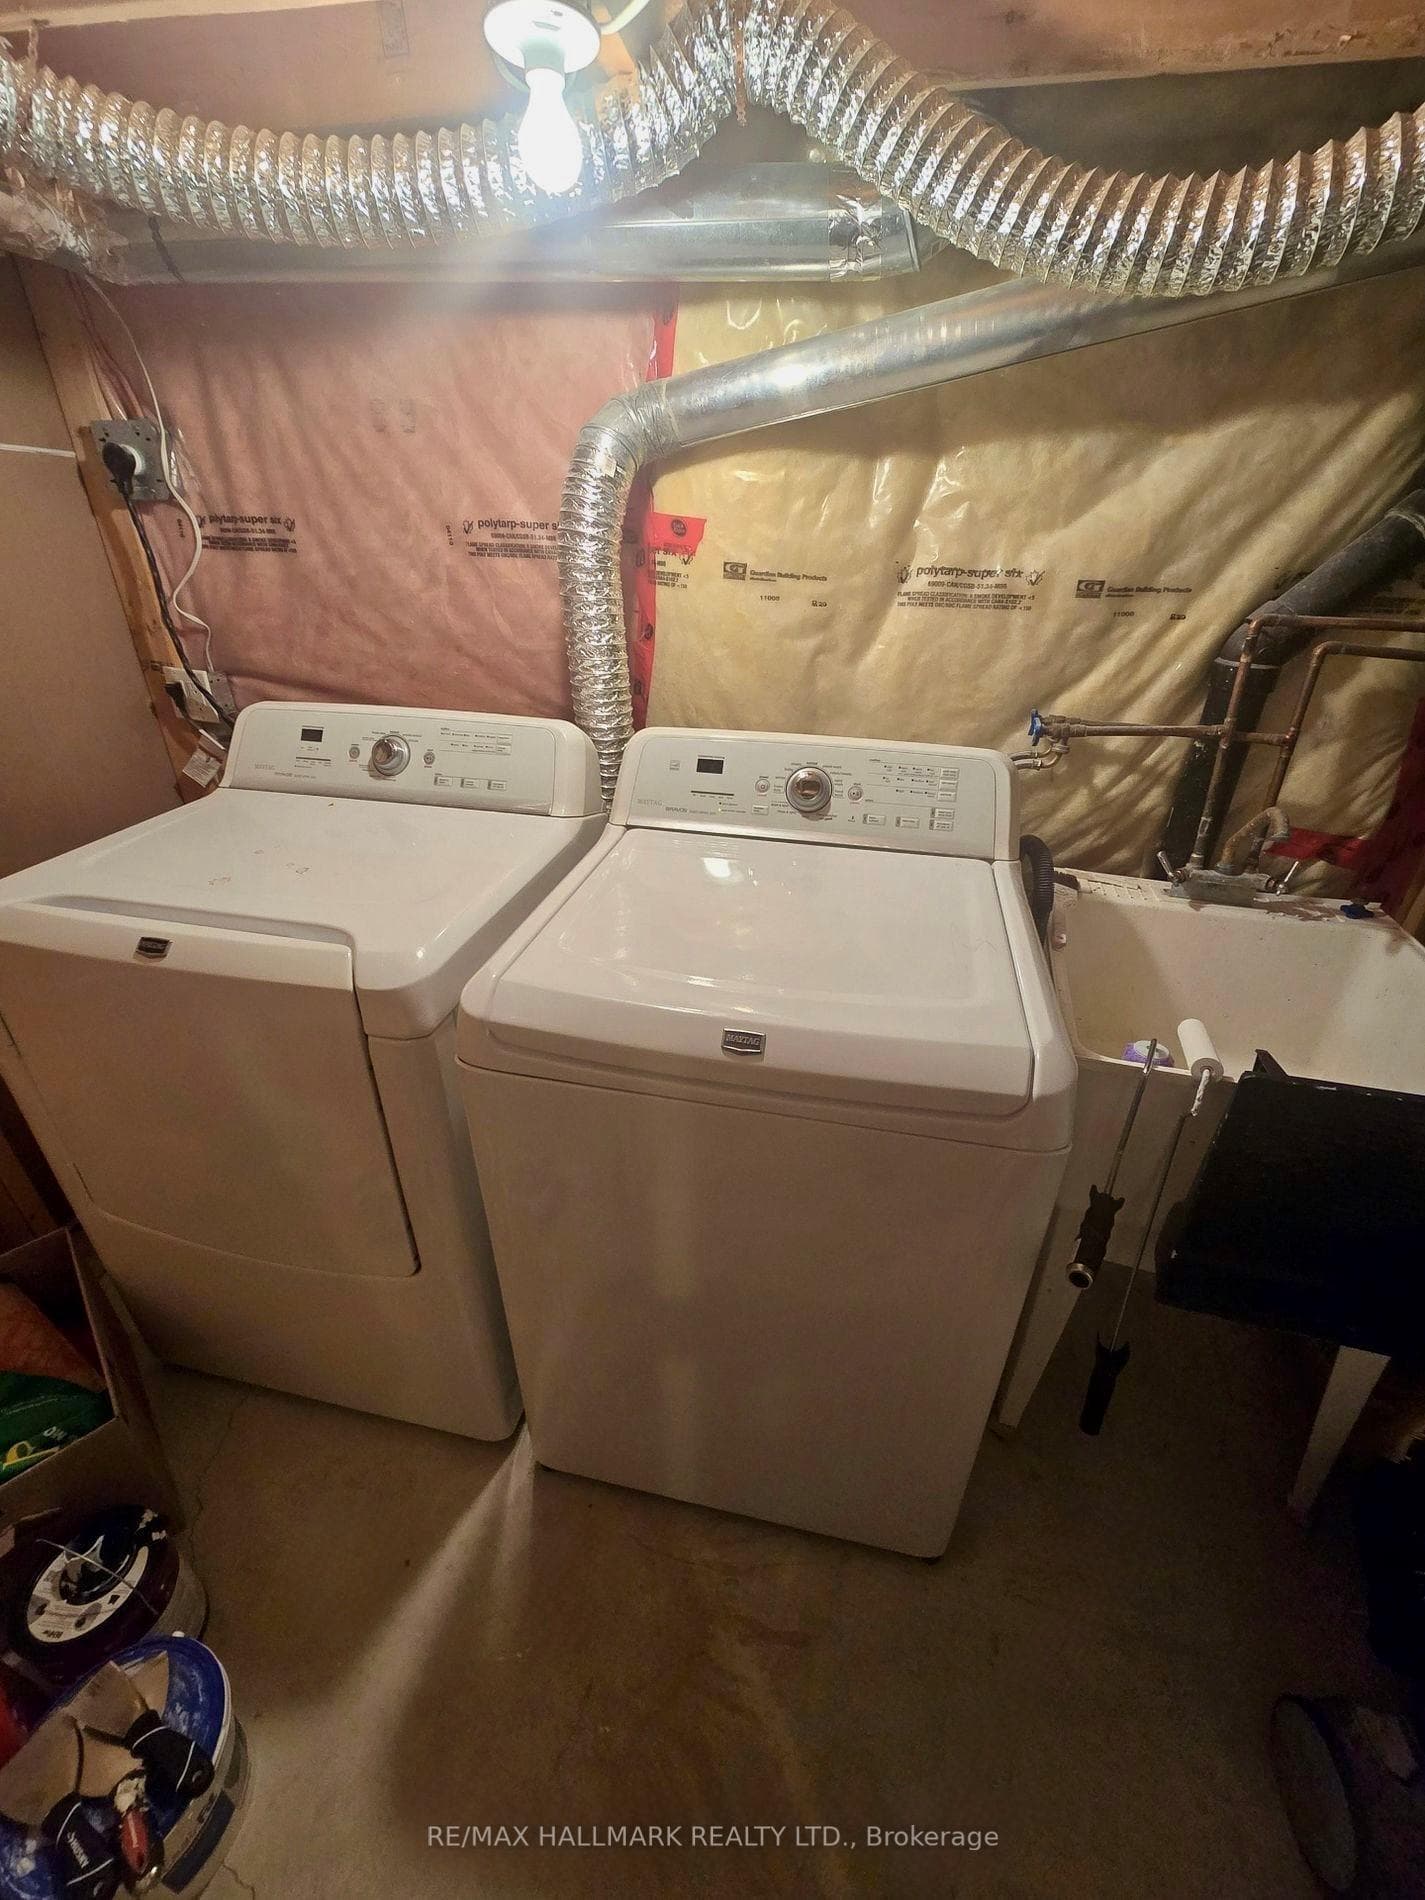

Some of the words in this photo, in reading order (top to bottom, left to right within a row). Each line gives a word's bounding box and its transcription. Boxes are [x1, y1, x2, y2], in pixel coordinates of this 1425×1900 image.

[477, 518, 550, 531] polytarp-super
[916, 564, 1003, 580] polytarp-super
[1004, 567, 1024, 578] six
[725, 1033, 761, 1046] MAYTAG
